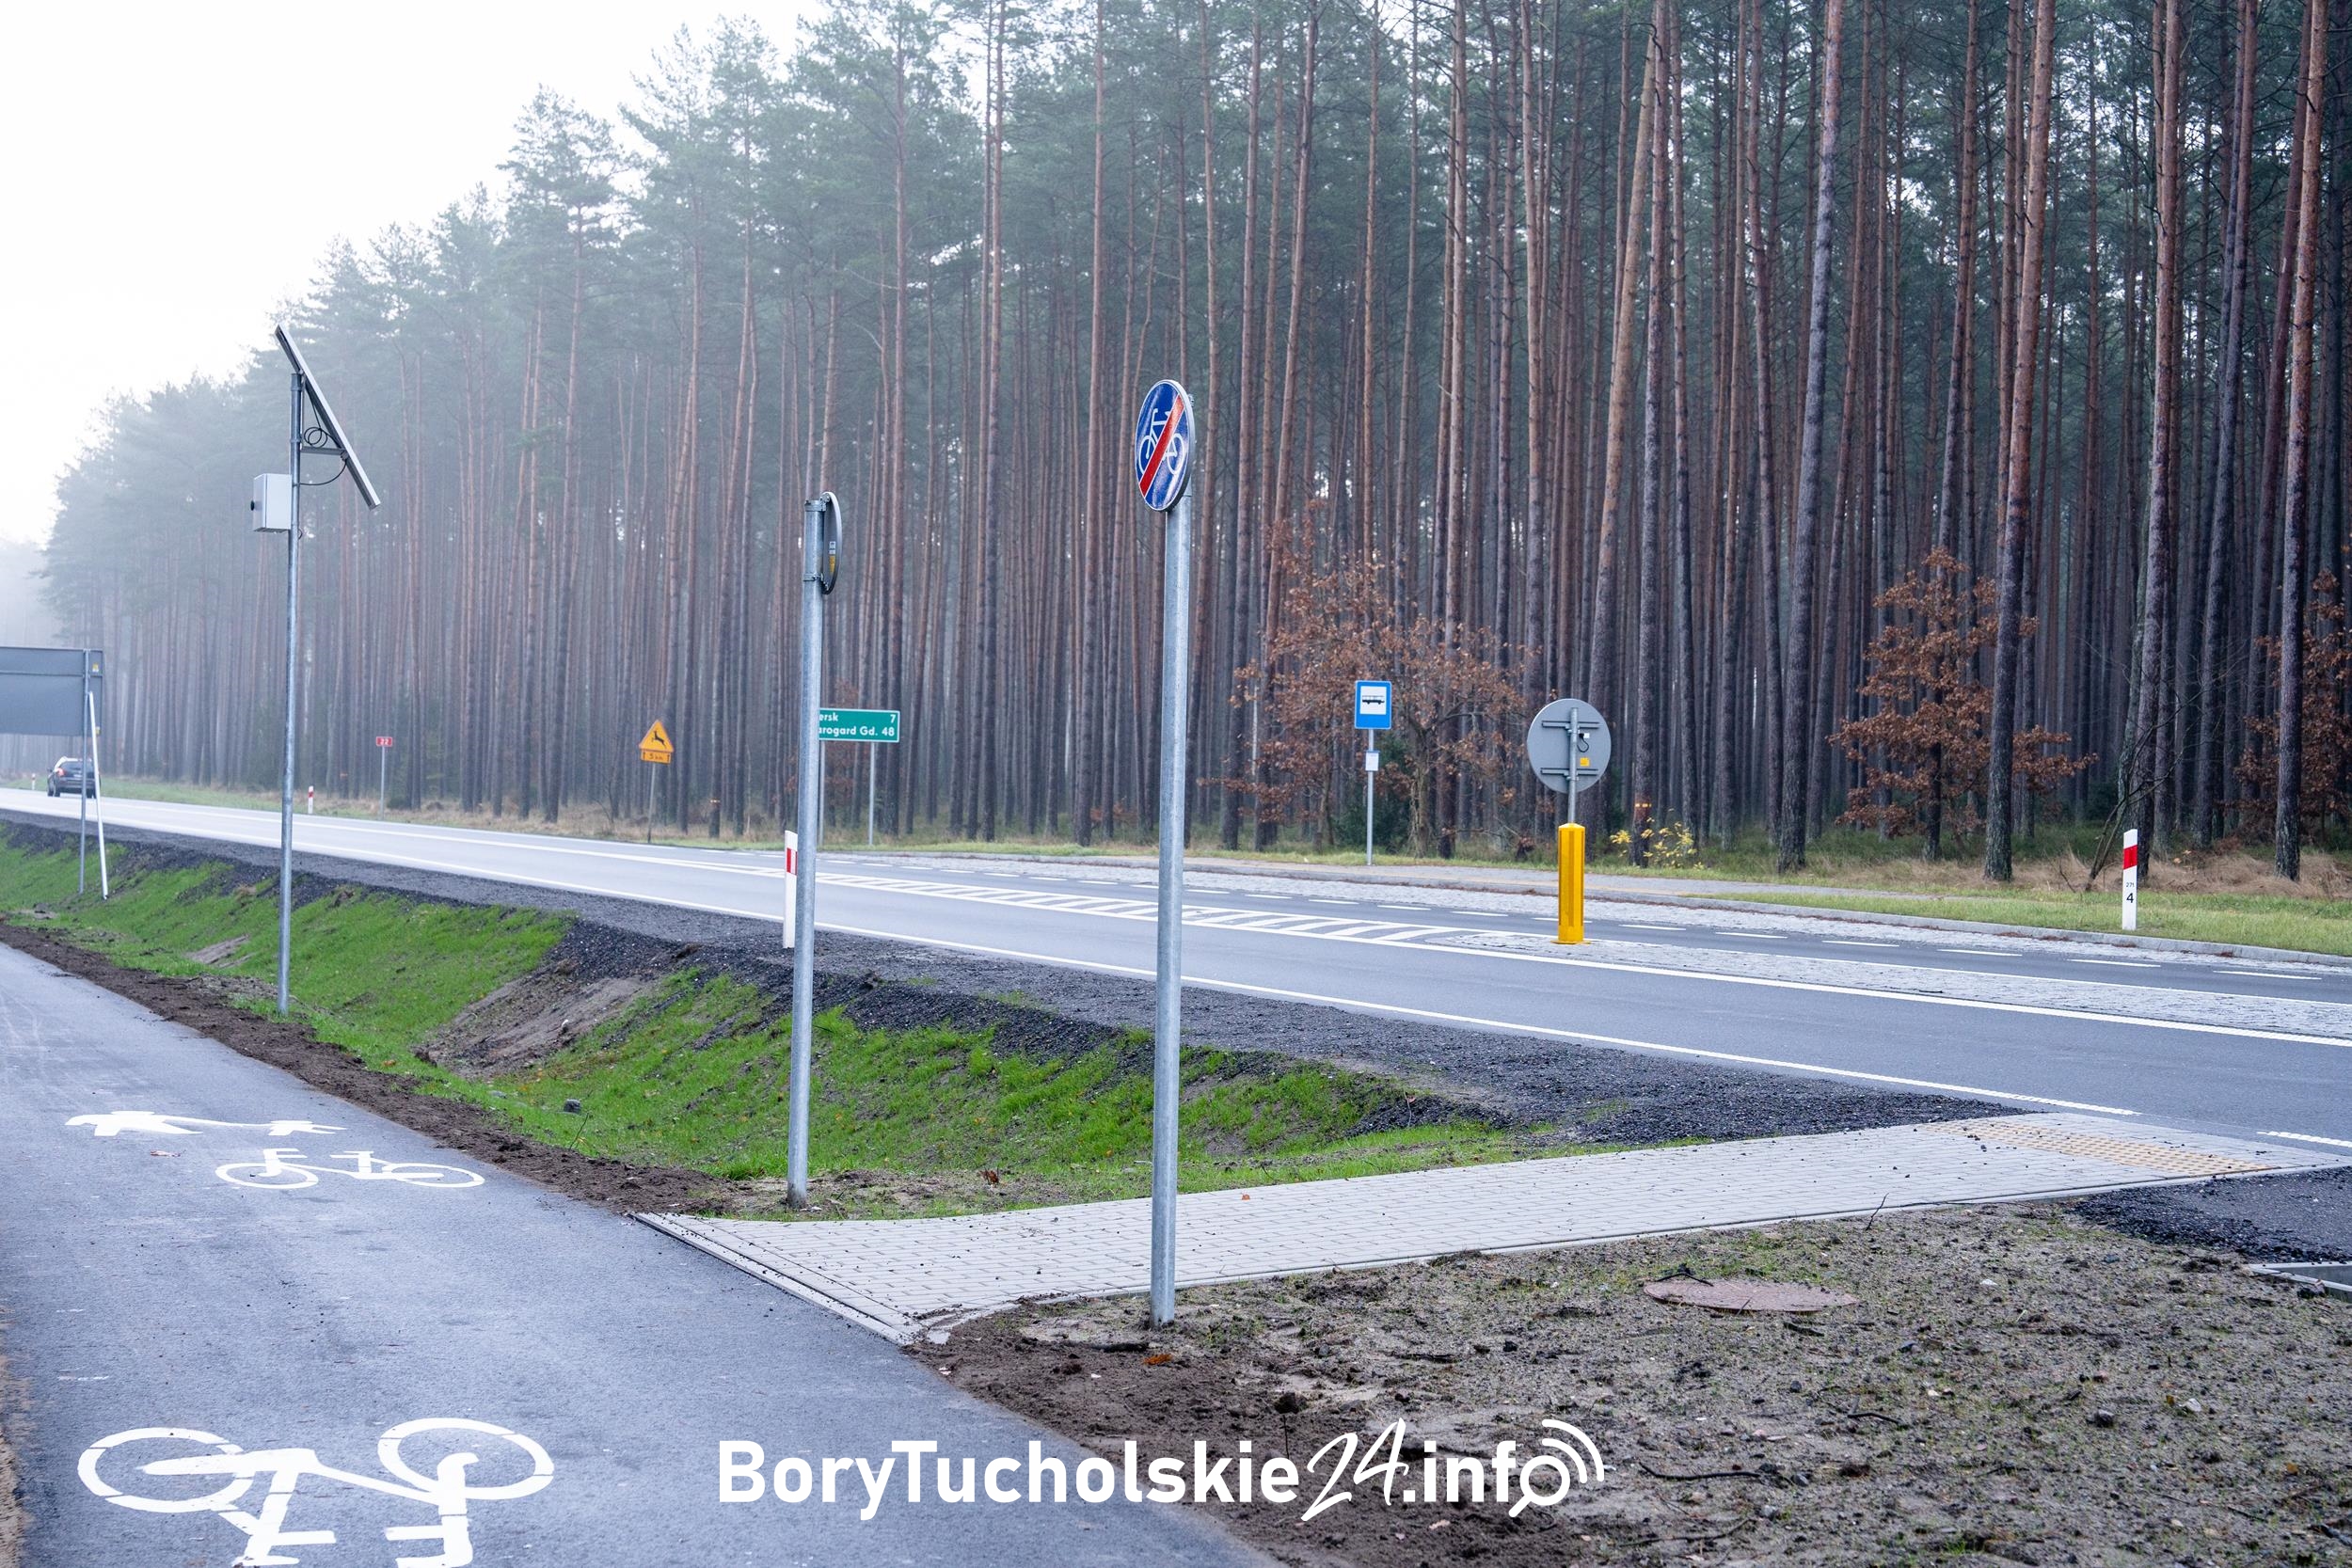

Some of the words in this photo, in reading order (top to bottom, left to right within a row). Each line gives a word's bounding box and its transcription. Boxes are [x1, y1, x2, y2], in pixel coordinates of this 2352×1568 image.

[818, 712, 838, 721] ersk
[890, 714, 897, 723] 7
[818, 725, 857, 736] arogard
[859, 726, 878, 736] Gd.
[882, 727, 895, 736] 48
[2126, 893, 2134, 903] 4
